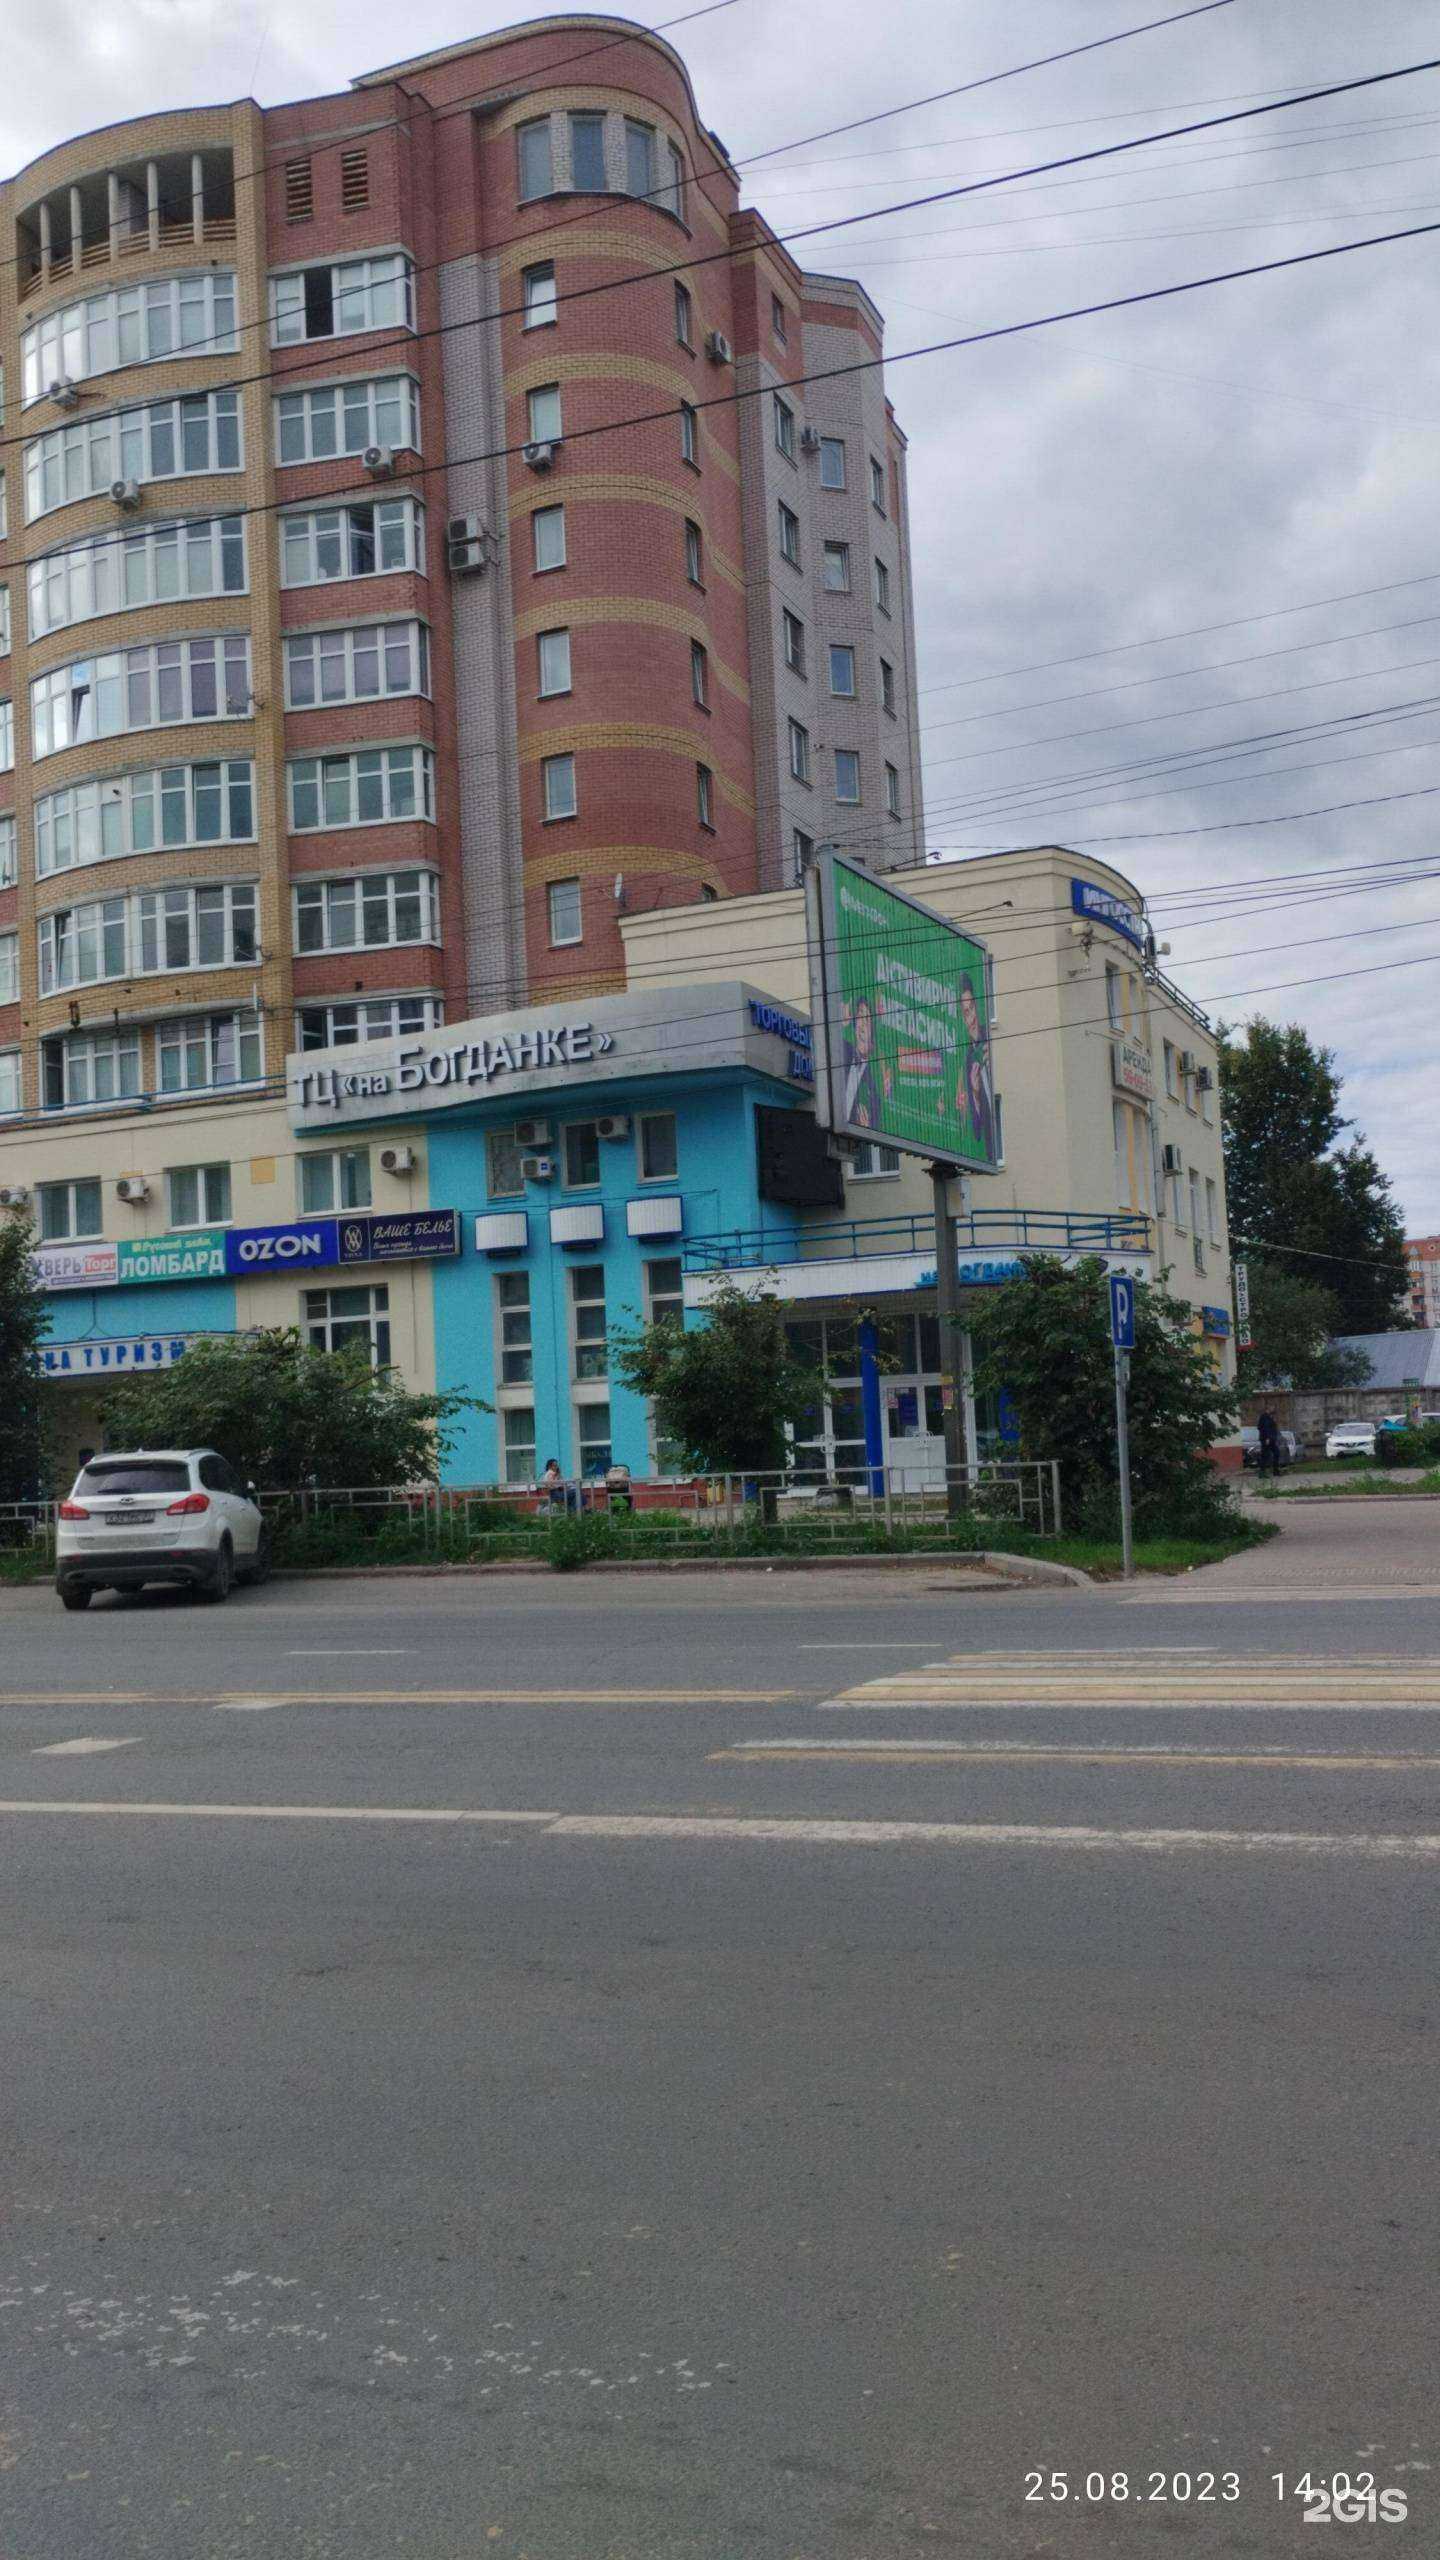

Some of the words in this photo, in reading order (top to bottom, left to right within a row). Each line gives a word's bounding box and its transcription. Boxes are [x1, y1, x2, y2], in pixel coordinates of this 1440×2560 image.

[748, 998, 811, 1050] ТОРГОВЫ
[788, 1048, 814, 1082] ДО
[295, 1069, 340, 1108] ТЦ
[373, 1222, 411, 1240] ВАШЕ
[120, 1249, 226, 1278] ЛОМБАРД
[239, 1234, 322, 1262] OZON
[36, 1256, 82, 1277] ВЕРЬ
[1116, 1283, 1129, 1340] P
